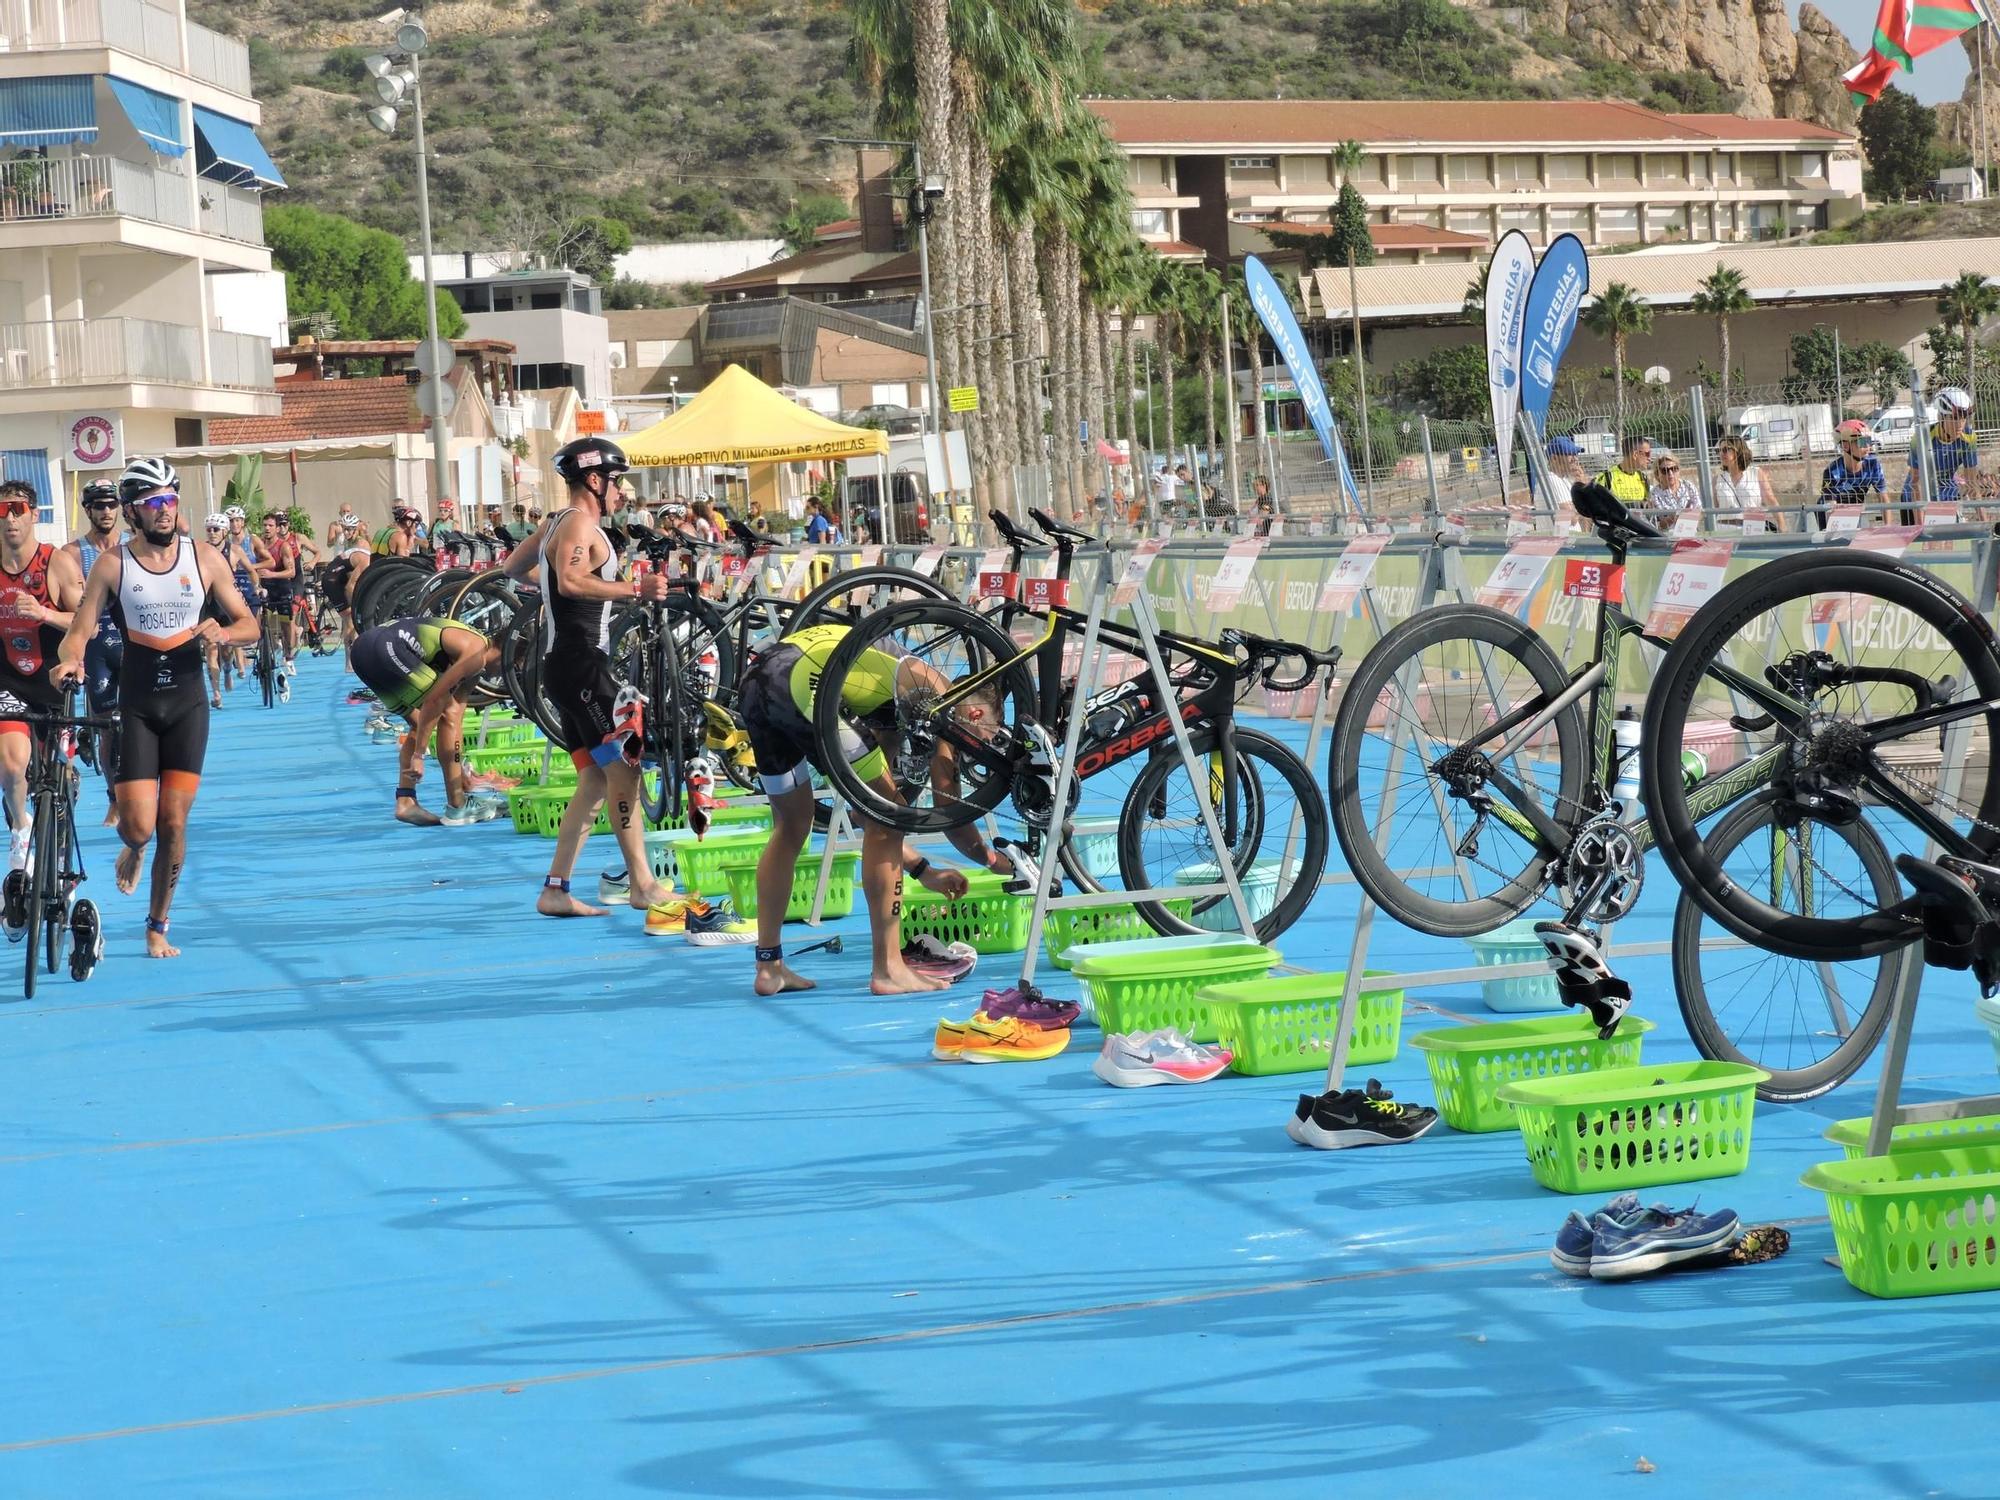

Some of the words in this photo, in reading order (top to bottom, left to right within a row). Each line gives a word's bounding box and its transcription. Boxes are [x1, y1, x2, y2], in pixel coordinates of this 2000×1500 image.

[1499, 259, 1521, 345] LOTERÍAS
[1540, 263, 1576, 342] LOTERÍAS
[628, 455, 660, 466] NATO
[663, 450, 729, 465] DEPORTIVO
[732, 447, 790, 461] MUNICIPAL
[730, 560, 741, 570] 63
[1498, 562, 1517, 581] 54
[1580, 566, 1601, 585] 53
[990, 575, 1004, 588] 59
[1034, 582, 1048, 595] 58
[1666, 572, 1685, 596] 53
[135, 602, 163, 611] CAXTON
[139, 611, 187, 631] ROSALENY
[1085, 681, 1139, 712] BEA
[1594, 611, 1620, 790] REACT
[1077, 703, 1204, 776] ORBEA
[455, 740, 460, 763] 68
[1637, 752, 1778, 850] MRIDA
[618, 801, 631, 830] 62
[892, 881, 902, 916] 58
